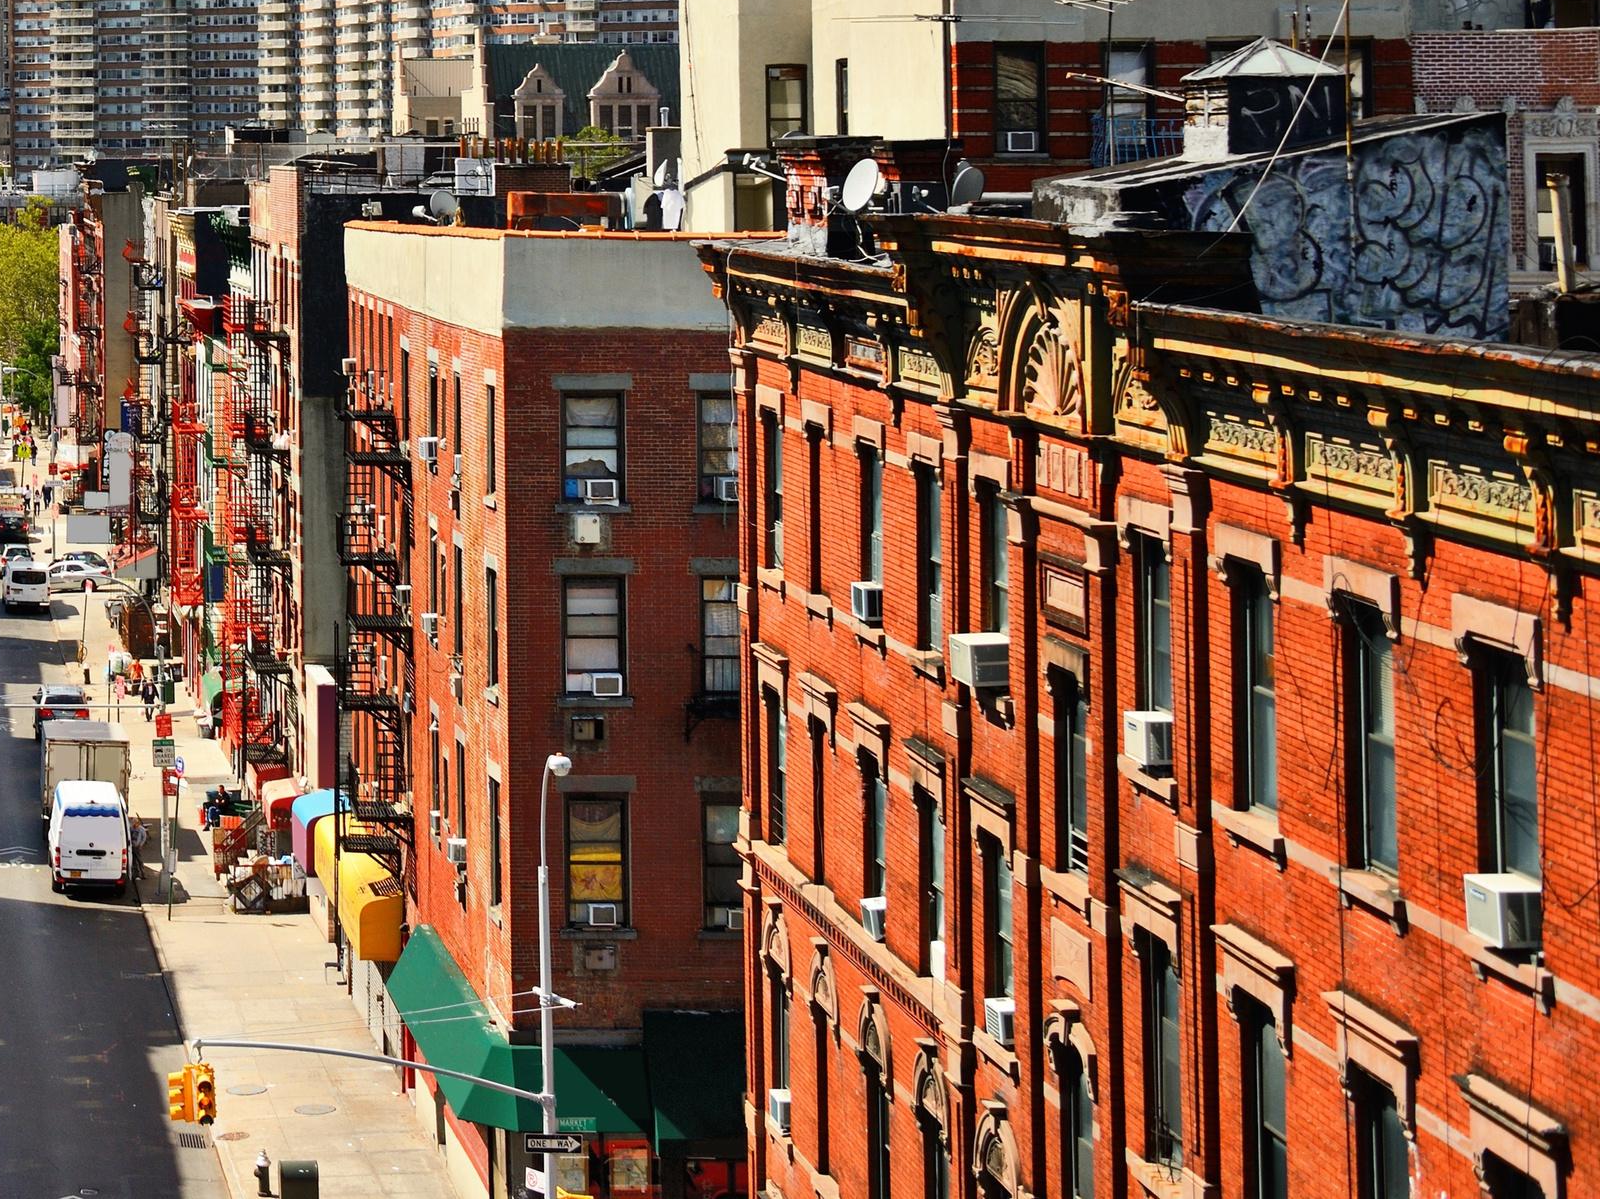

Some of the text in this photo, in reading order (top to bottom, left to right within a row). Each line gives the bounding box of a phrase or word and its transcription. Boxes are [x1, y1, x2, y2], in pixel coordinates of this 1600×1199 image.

[559, 1119, 586, 1127] MARKET
[530, 1139, 574, 1148] ONE WAY
